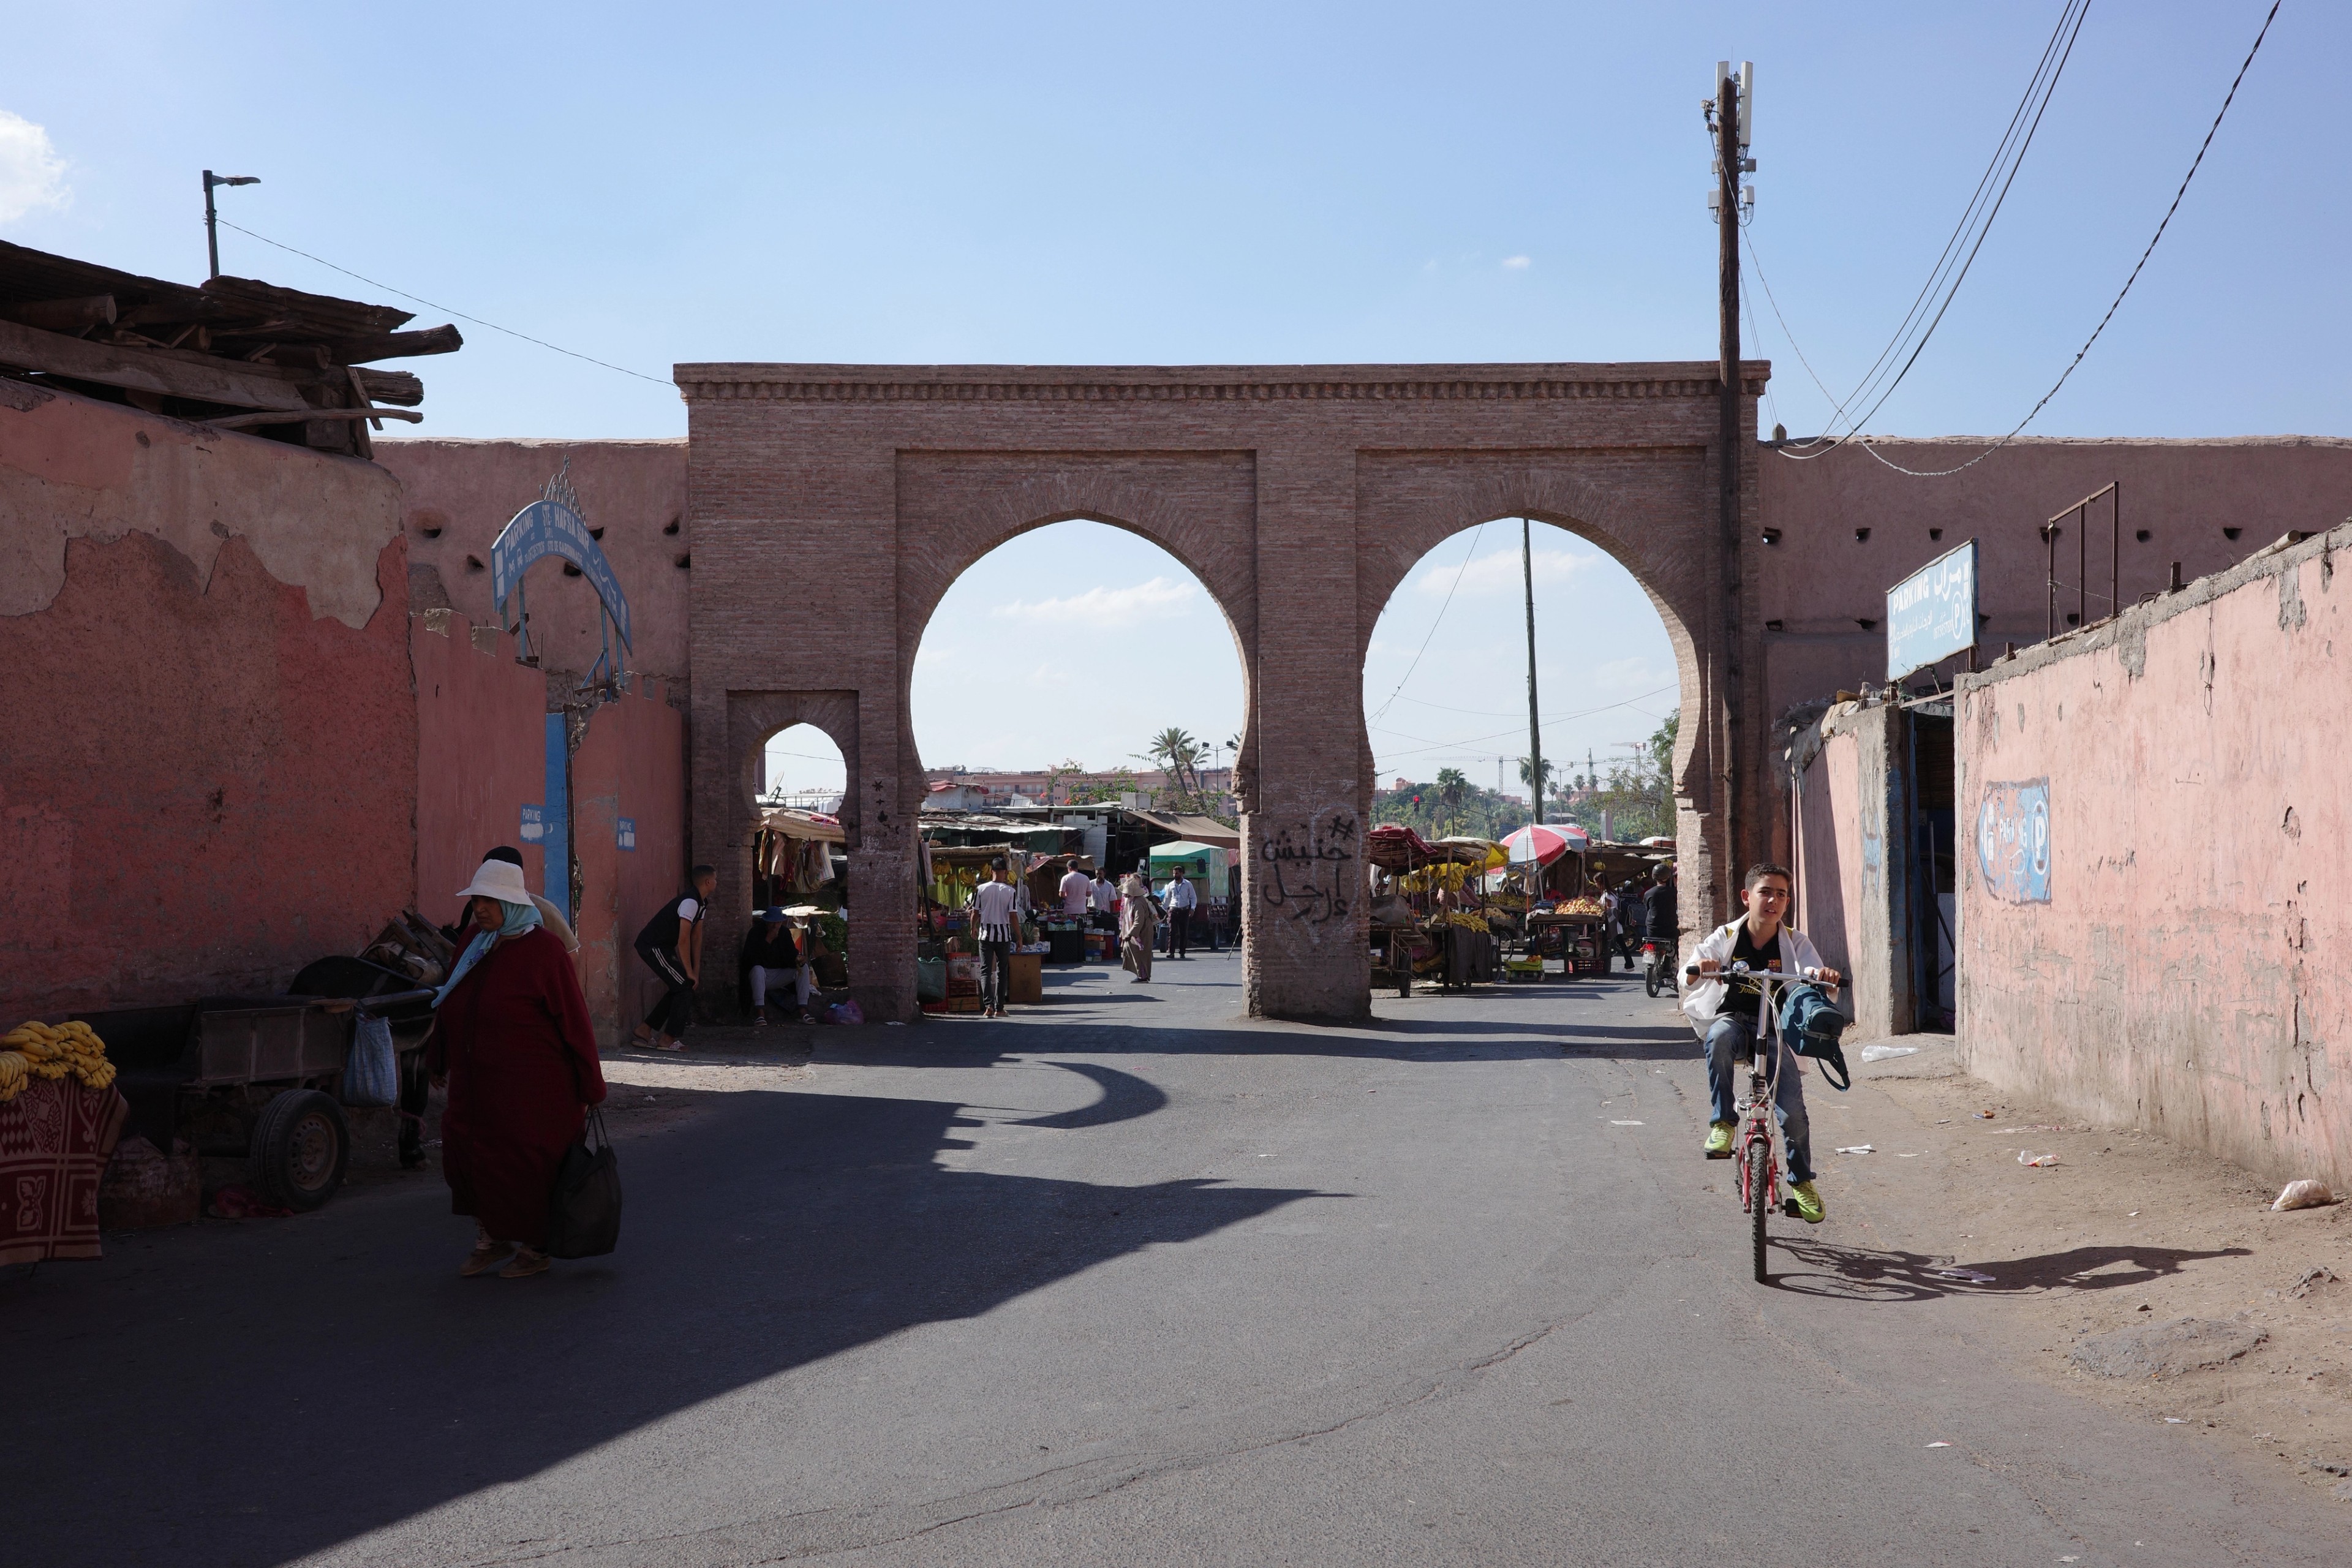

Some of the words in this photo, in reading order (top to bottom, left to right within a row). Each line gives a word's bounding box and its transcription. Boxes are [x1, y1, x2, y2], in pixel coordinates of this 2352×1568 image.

[505, 510, 533, 557] PARKING
[554, 505, 576, 538] HAFSA
[1893, 573, 1929, 616] PARKING
[1954, 603, 1960, 629] P
[522, 808, 541, 821] PARKING
[619, 821, 631, 832] PARKING
[2034, 816, 2046, 859] P
